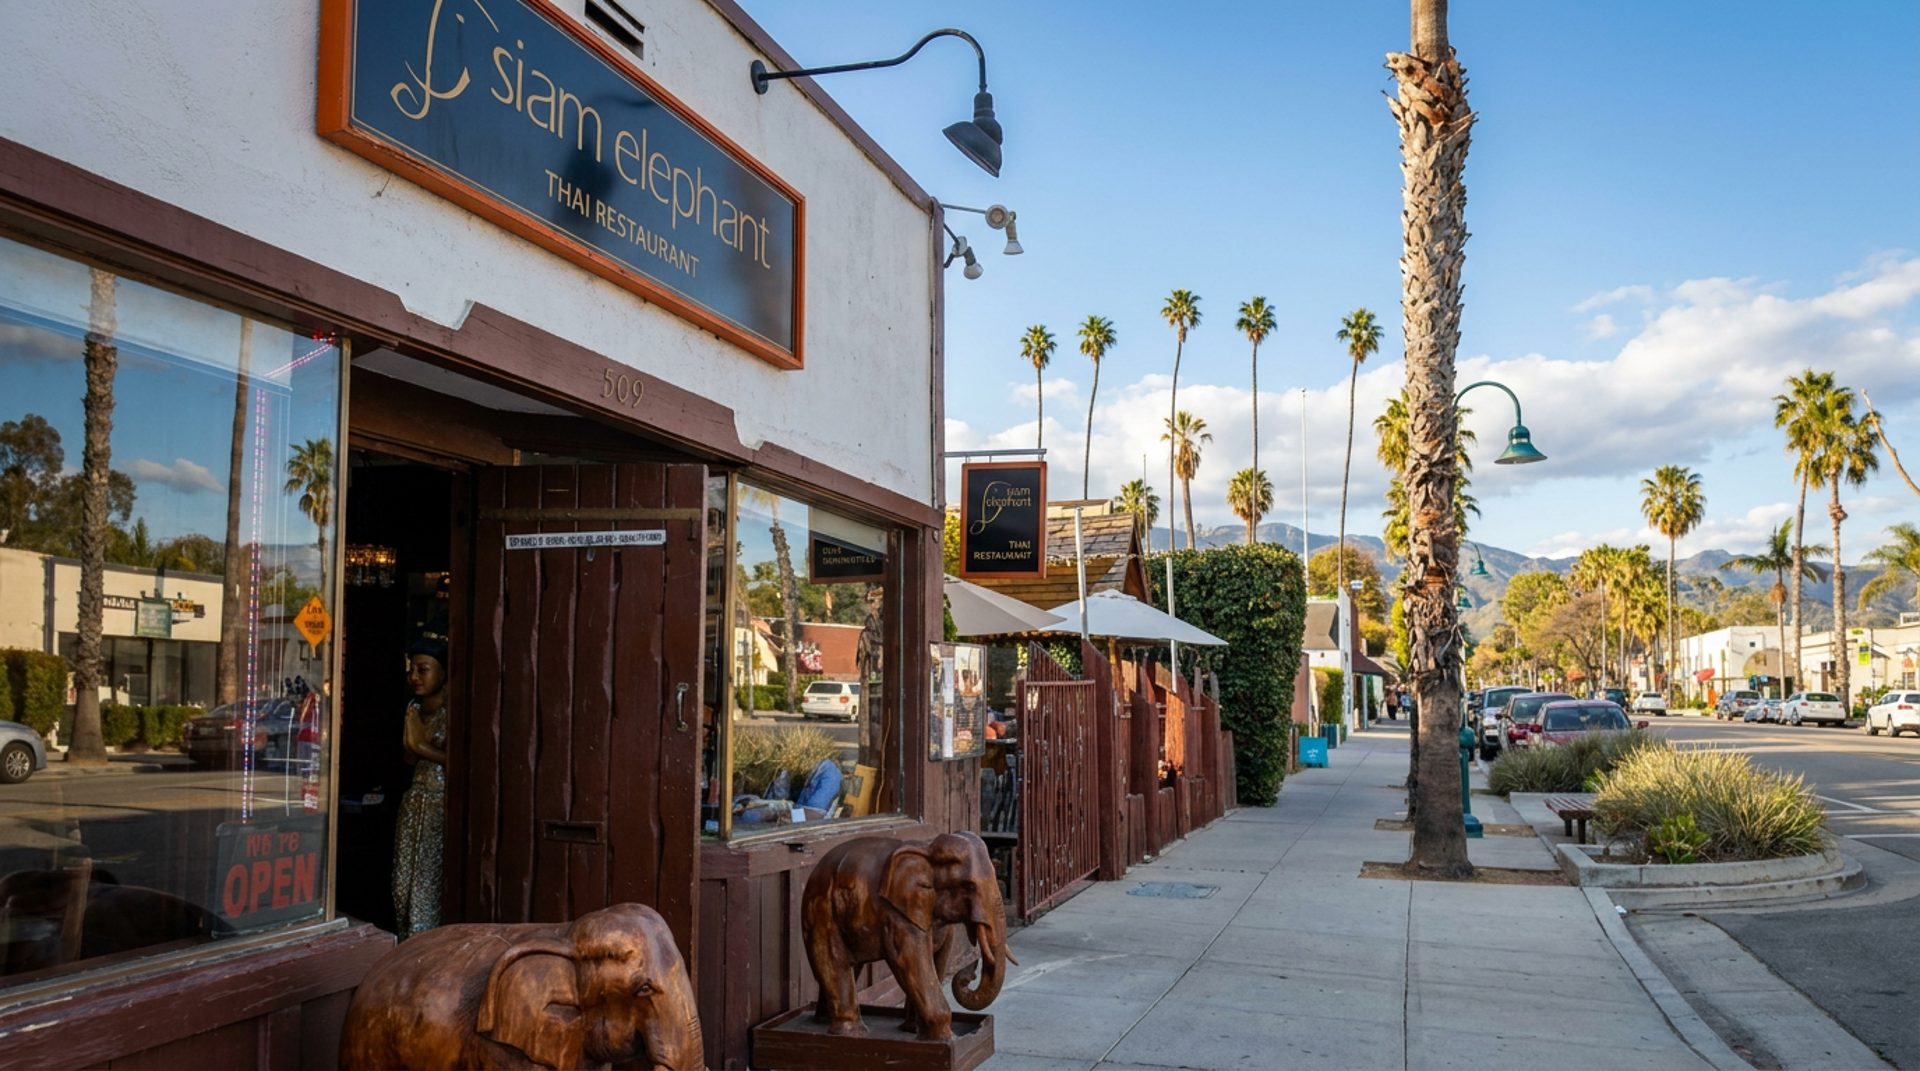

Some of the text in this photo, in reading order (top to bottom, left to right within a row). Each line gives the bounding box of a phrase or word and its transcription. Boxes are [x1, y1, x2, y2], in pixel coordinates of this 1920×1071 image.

[491, 39, 771, 269] siam elephant
[545, 169, 699, 278] THAI RESTAURANT
[602, 368, 644, 408] 509
[1008, 540, 1031, 549] THAI
[223, 853, 316, 918] OPEN
